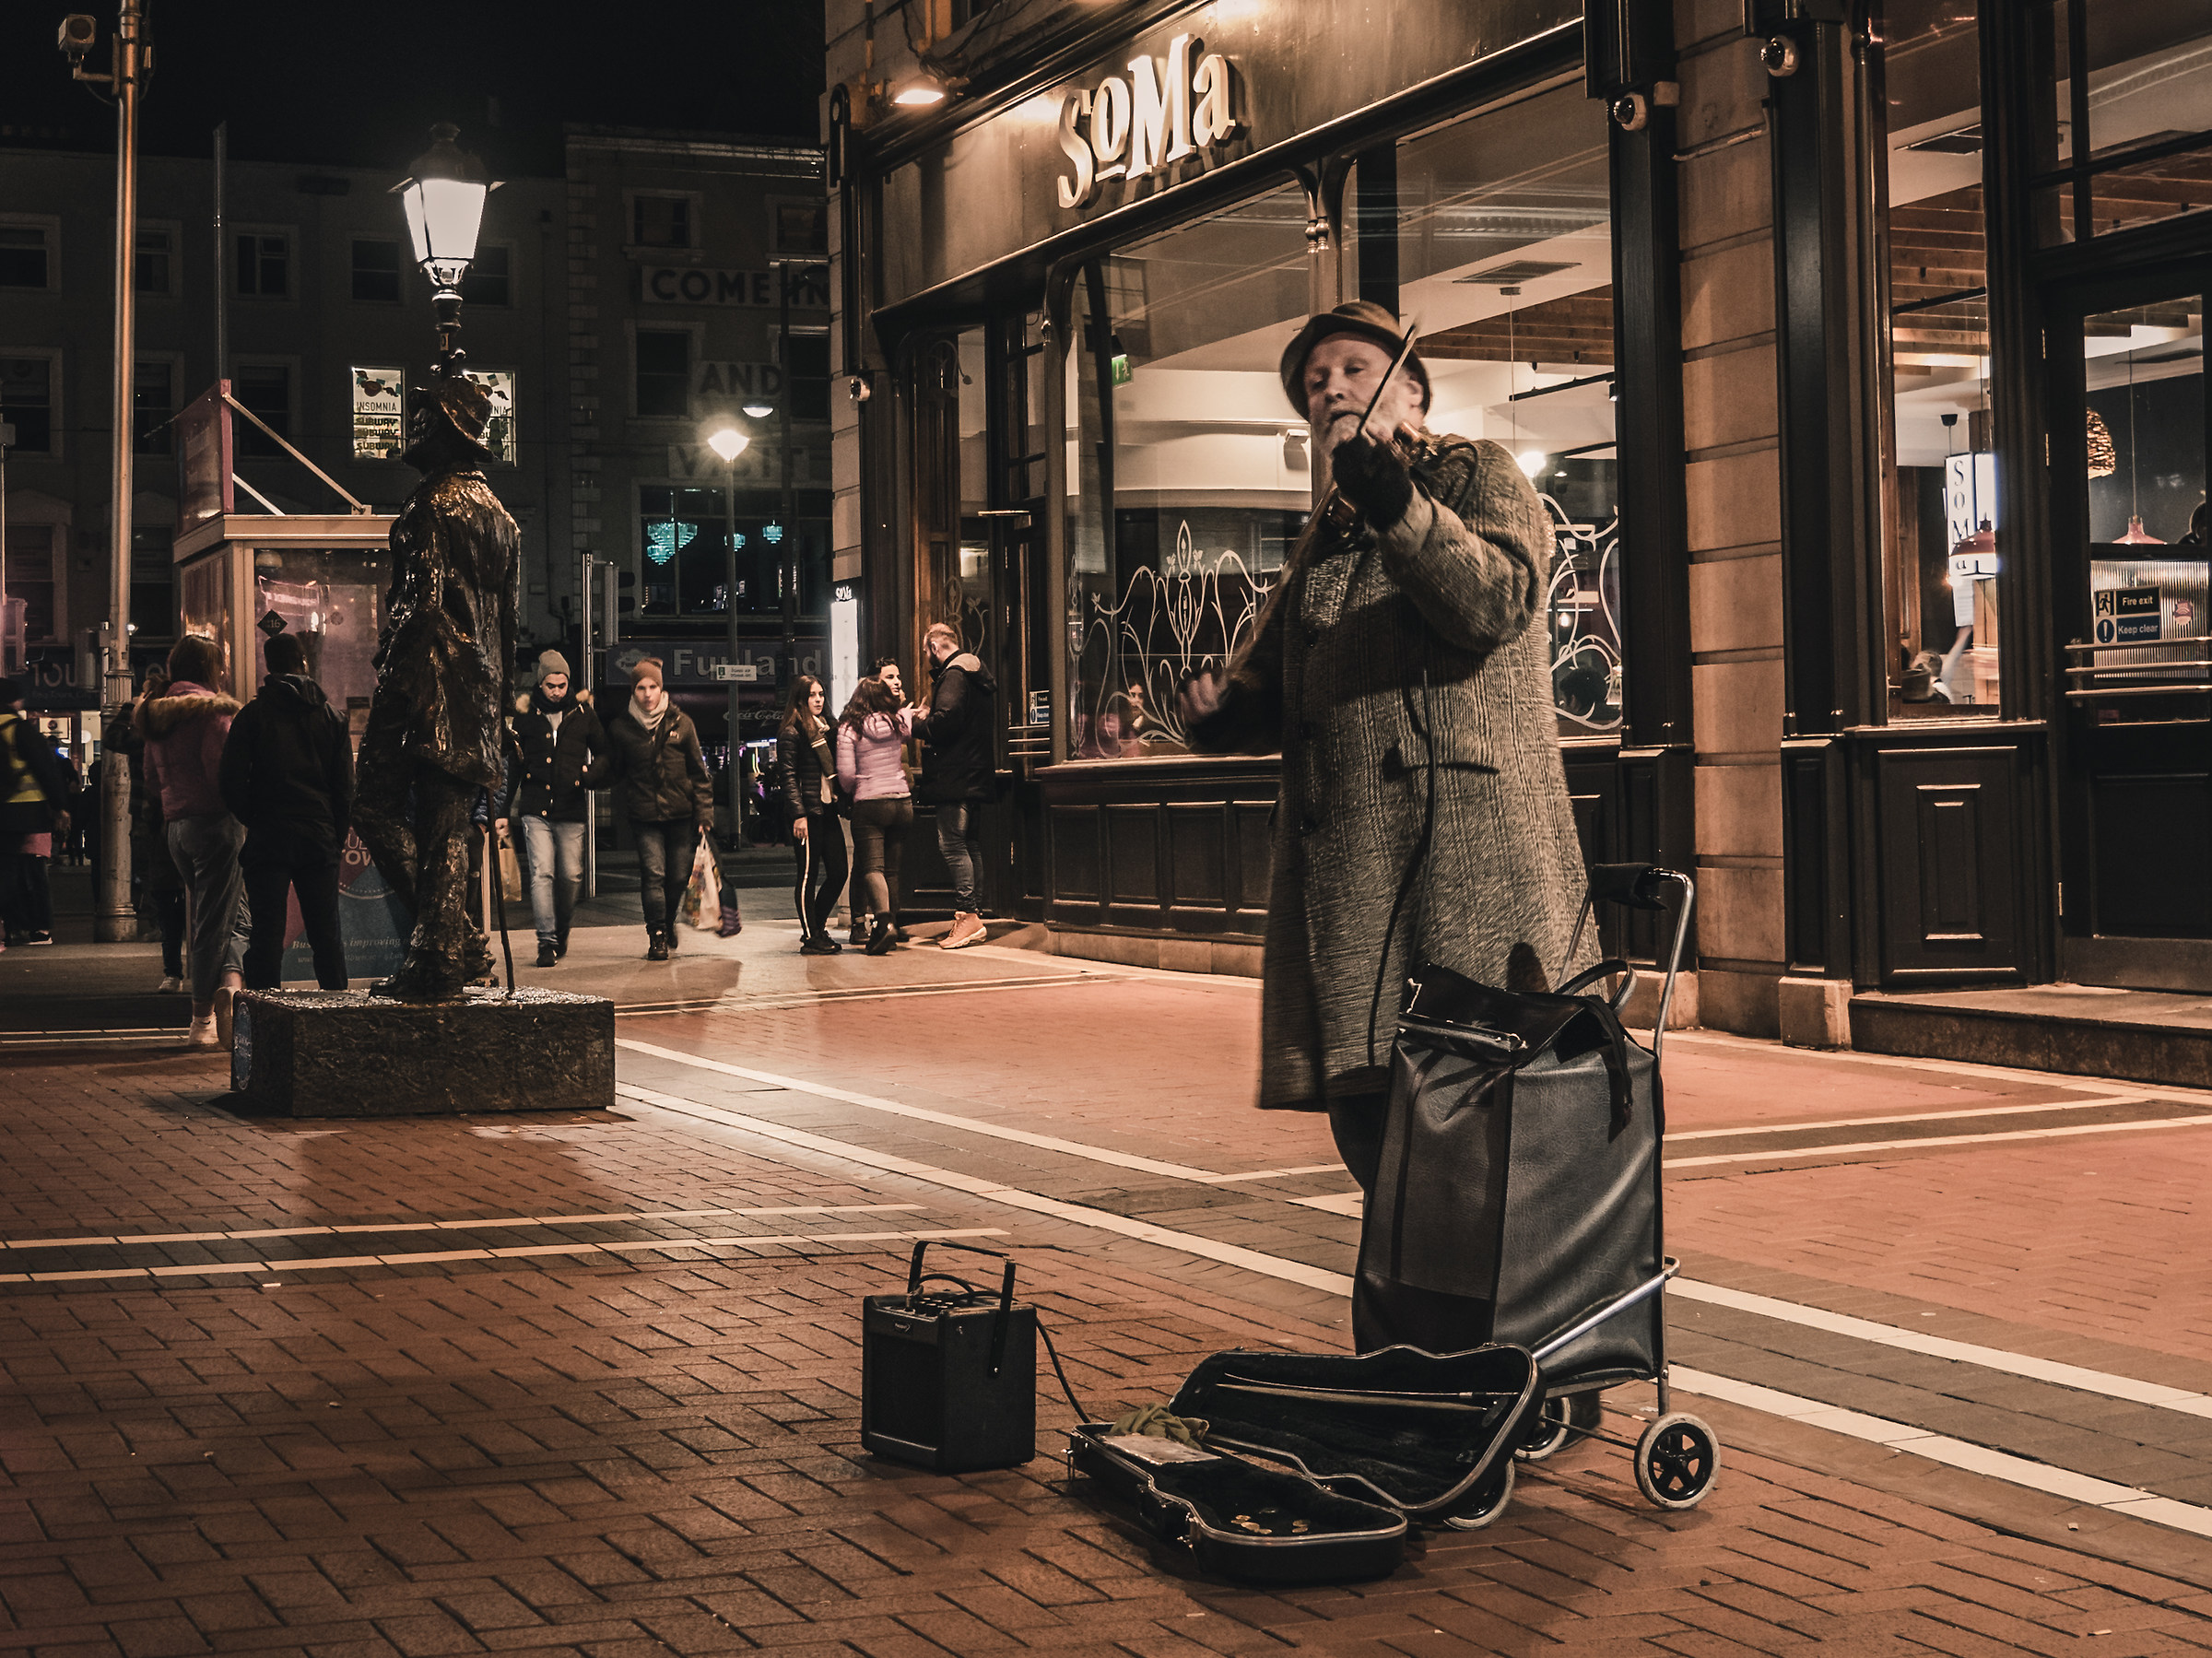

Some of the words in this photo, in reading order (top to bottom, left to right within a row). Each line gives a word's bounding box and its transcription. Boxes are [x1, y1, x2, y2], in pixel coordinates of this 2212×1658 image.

[652, 269, 770, 303] COME
[699, 363, 783, 394] AND
[357, 402, 396, 412] INSOMNIA
[2123, 597, 2136, 606] Fire
[2138, 595, 2153, 606] exit
[2118, 626, 2137, 636] Keep
[2139, 624, 2159, 633] clear
